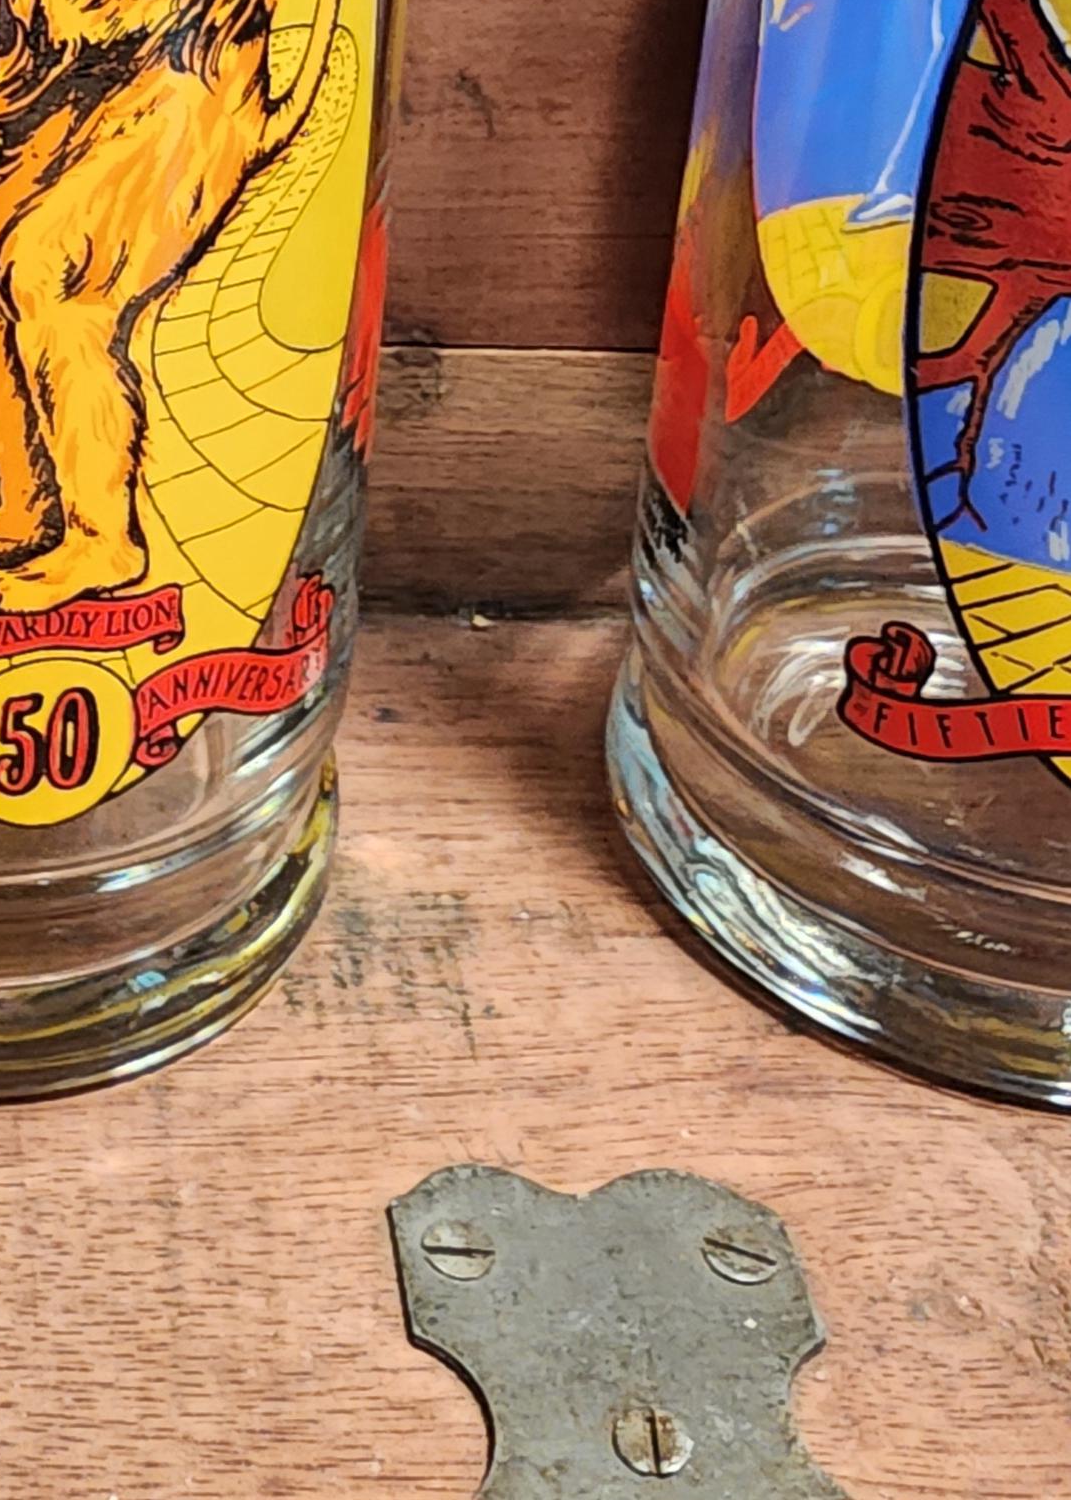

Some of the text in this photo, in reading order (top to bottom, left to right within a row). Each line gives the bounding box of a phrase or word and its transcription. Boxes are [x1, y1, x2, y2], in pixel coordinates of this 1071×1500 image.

[105, 598, 177, 638] LION
[146, 636, 325, 719] ANNIVERSARY
[874, 702, 1067, 749] FIFTIE
